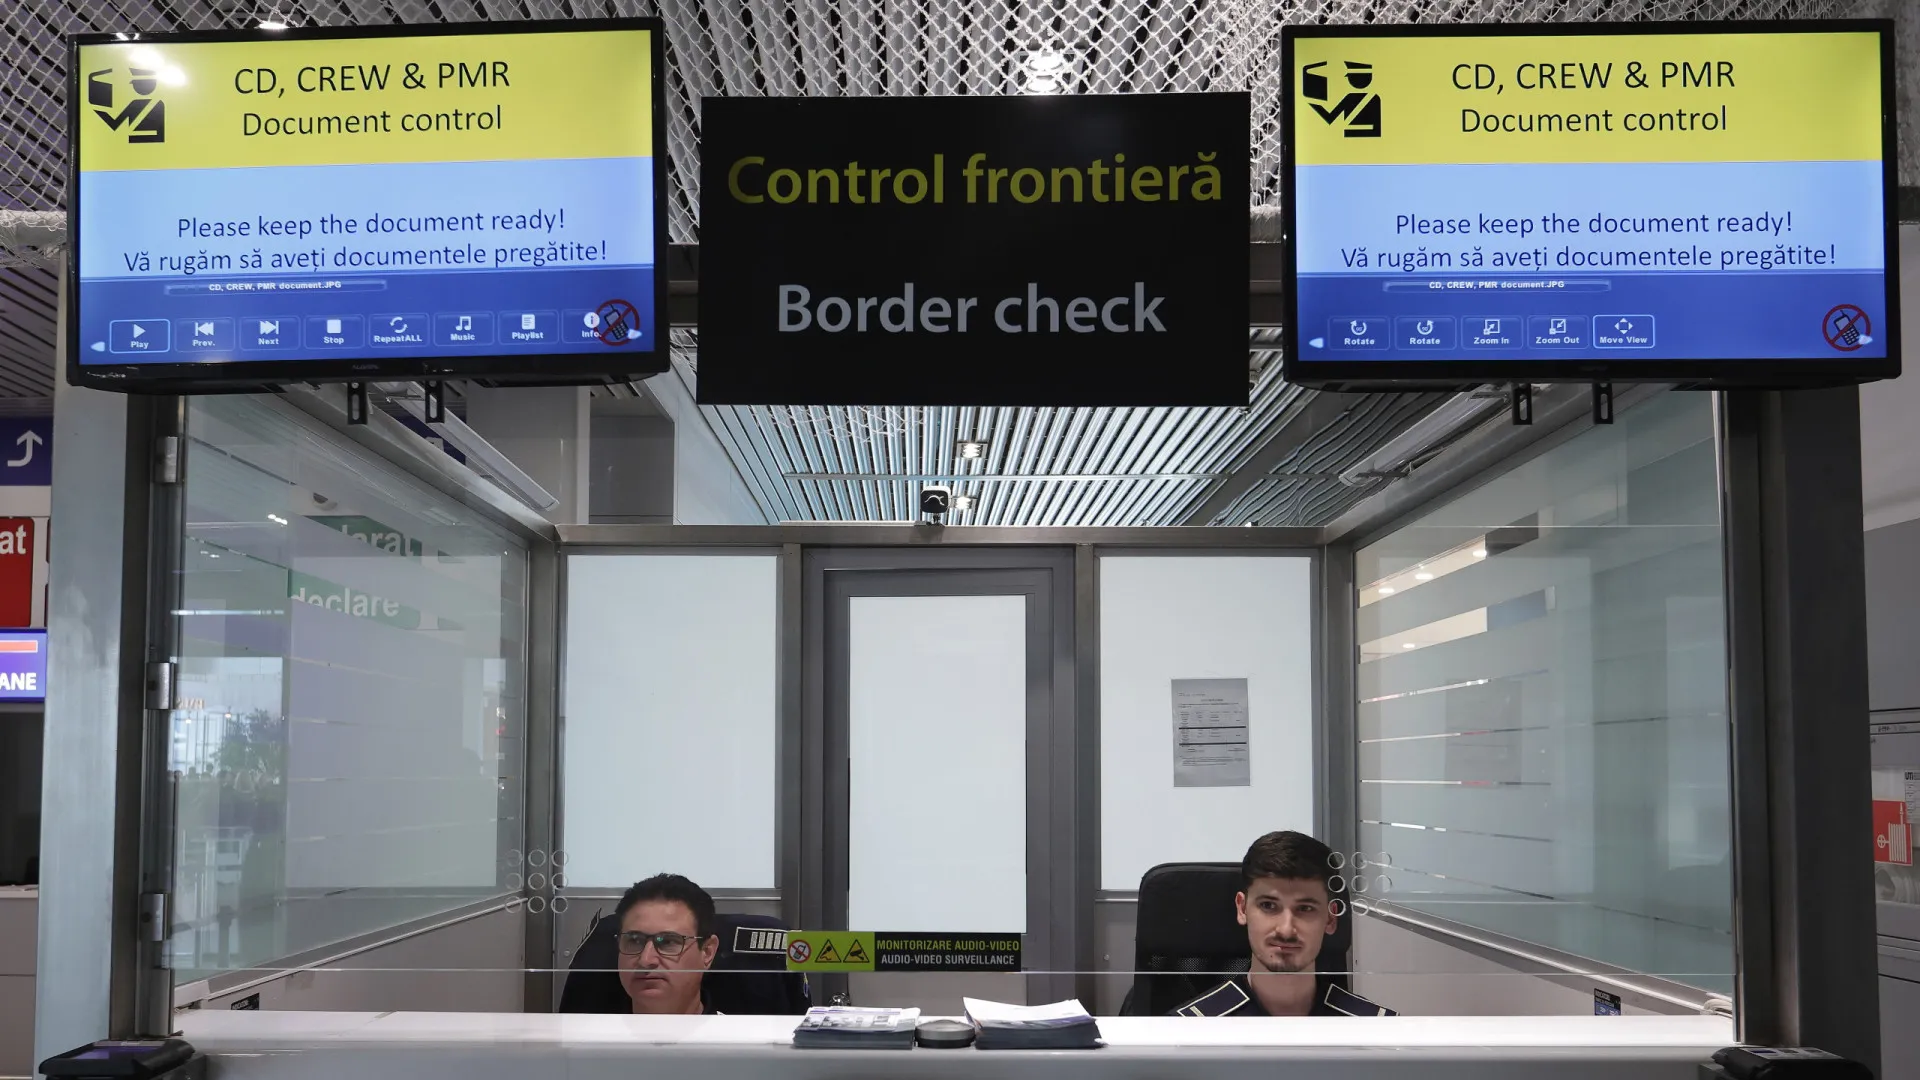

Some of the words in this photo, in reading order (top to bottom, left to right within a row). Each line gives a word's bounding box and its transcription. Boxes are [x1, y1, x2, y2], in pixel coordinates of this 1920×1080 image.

[235, 68, 285, 98] CD,
[297, 64, 391, 92] CREW
[402, 62, 426, 89] &
[439, 61, 510, 88] PMR
[1452, 63, 1504, 95] CD,
[1516, 63, 1613, 89] CREW
[1624, 61, 1649, 88] &
[1661, 61, 1735, 88] PMR
[243, 110, 391, 136] Document
[401, 104, 501, 132] control
[1461, 109, 1613, 132] Document
[1623, 105, 1726, 131] control
[727, 153, 944, 204] Control
[962, 151, 1222, 204] frontieră
[178, 217, 251, 238] Please
[258, 215, 312, 239] keep
[320, 213, 357, 235] the
[366, 212, 484, 233] document
[492, 208, 565, 234] ready!
[1397, 213, 1471, 234] Please
[1479, 213, 1533, 238] keep
[1541, 213, 1580, 233] the
[1589, 212, 1710, 233] document
[1718, 211, 1792, 236] ready!
[124, 251, 150, 272] Vă
[160, 250, 231, 275] rugăm
[239, 248, 262, 269] să
[271, 247, 325, 273] aveți
[334, 243, 486, 267] documentele
[495, 240, 606, 268] pregătite!
[1341, 247, 1368, 267] Vă
[1378, 246, 1451, 272] rugăm
[1460, 246, 1483, 267] să
[1492, 247, 1547, 271] aveți
[1556, 245, 1712, 267] documentele
[1721, 244, 1836, 270] pregătite!
[208, 283, 224, 292] CD,
[226, 283, 255, 291] CREW,
[257, 282, 276, 290] PMR
[279, 281, 341, 289] document.JPG
[1429, 281, 1444, 290] CD,
[1447, 281, 1477, 290] CREW,
[1479, 281, 1497, 289] PMR
[778, 282, 977, 333] Border
[994, 281, 1168, 333] check
[323, 336, 344, 345] Stop
[374, 334, 422, 343] RepeatALL
[450, 333, 475, 341] Music
[512, 331, 544, 340] Playlist
[1344, 337, 1375, 345] Rotate
[1409, 337, 1440, 345] Rotate
[1474, 336, 1498, 344] Zoom
[1501, 336, 1509, 344] In
[1536, 336, 1560, 344] Zoom
[1564, 336, 1580, 344] Out
[1599, 336, 1623, 344] Move
[1626, 336, 1648, 344] View
[130, 340, 149, 349] Play
[192, 339, 215, 347] Prev.
[0, 525, 26, 554] at
[0, 672, 36, 690] ANE
[877, 940, 951, 951] MONITORIZARE
[955, 940, 1019, 951] AUDIO-VIDEO
[881, 954, 942, 965] AUDIO-VIDEO
[945, 954, 1015, 965] SURVEILLANCE
